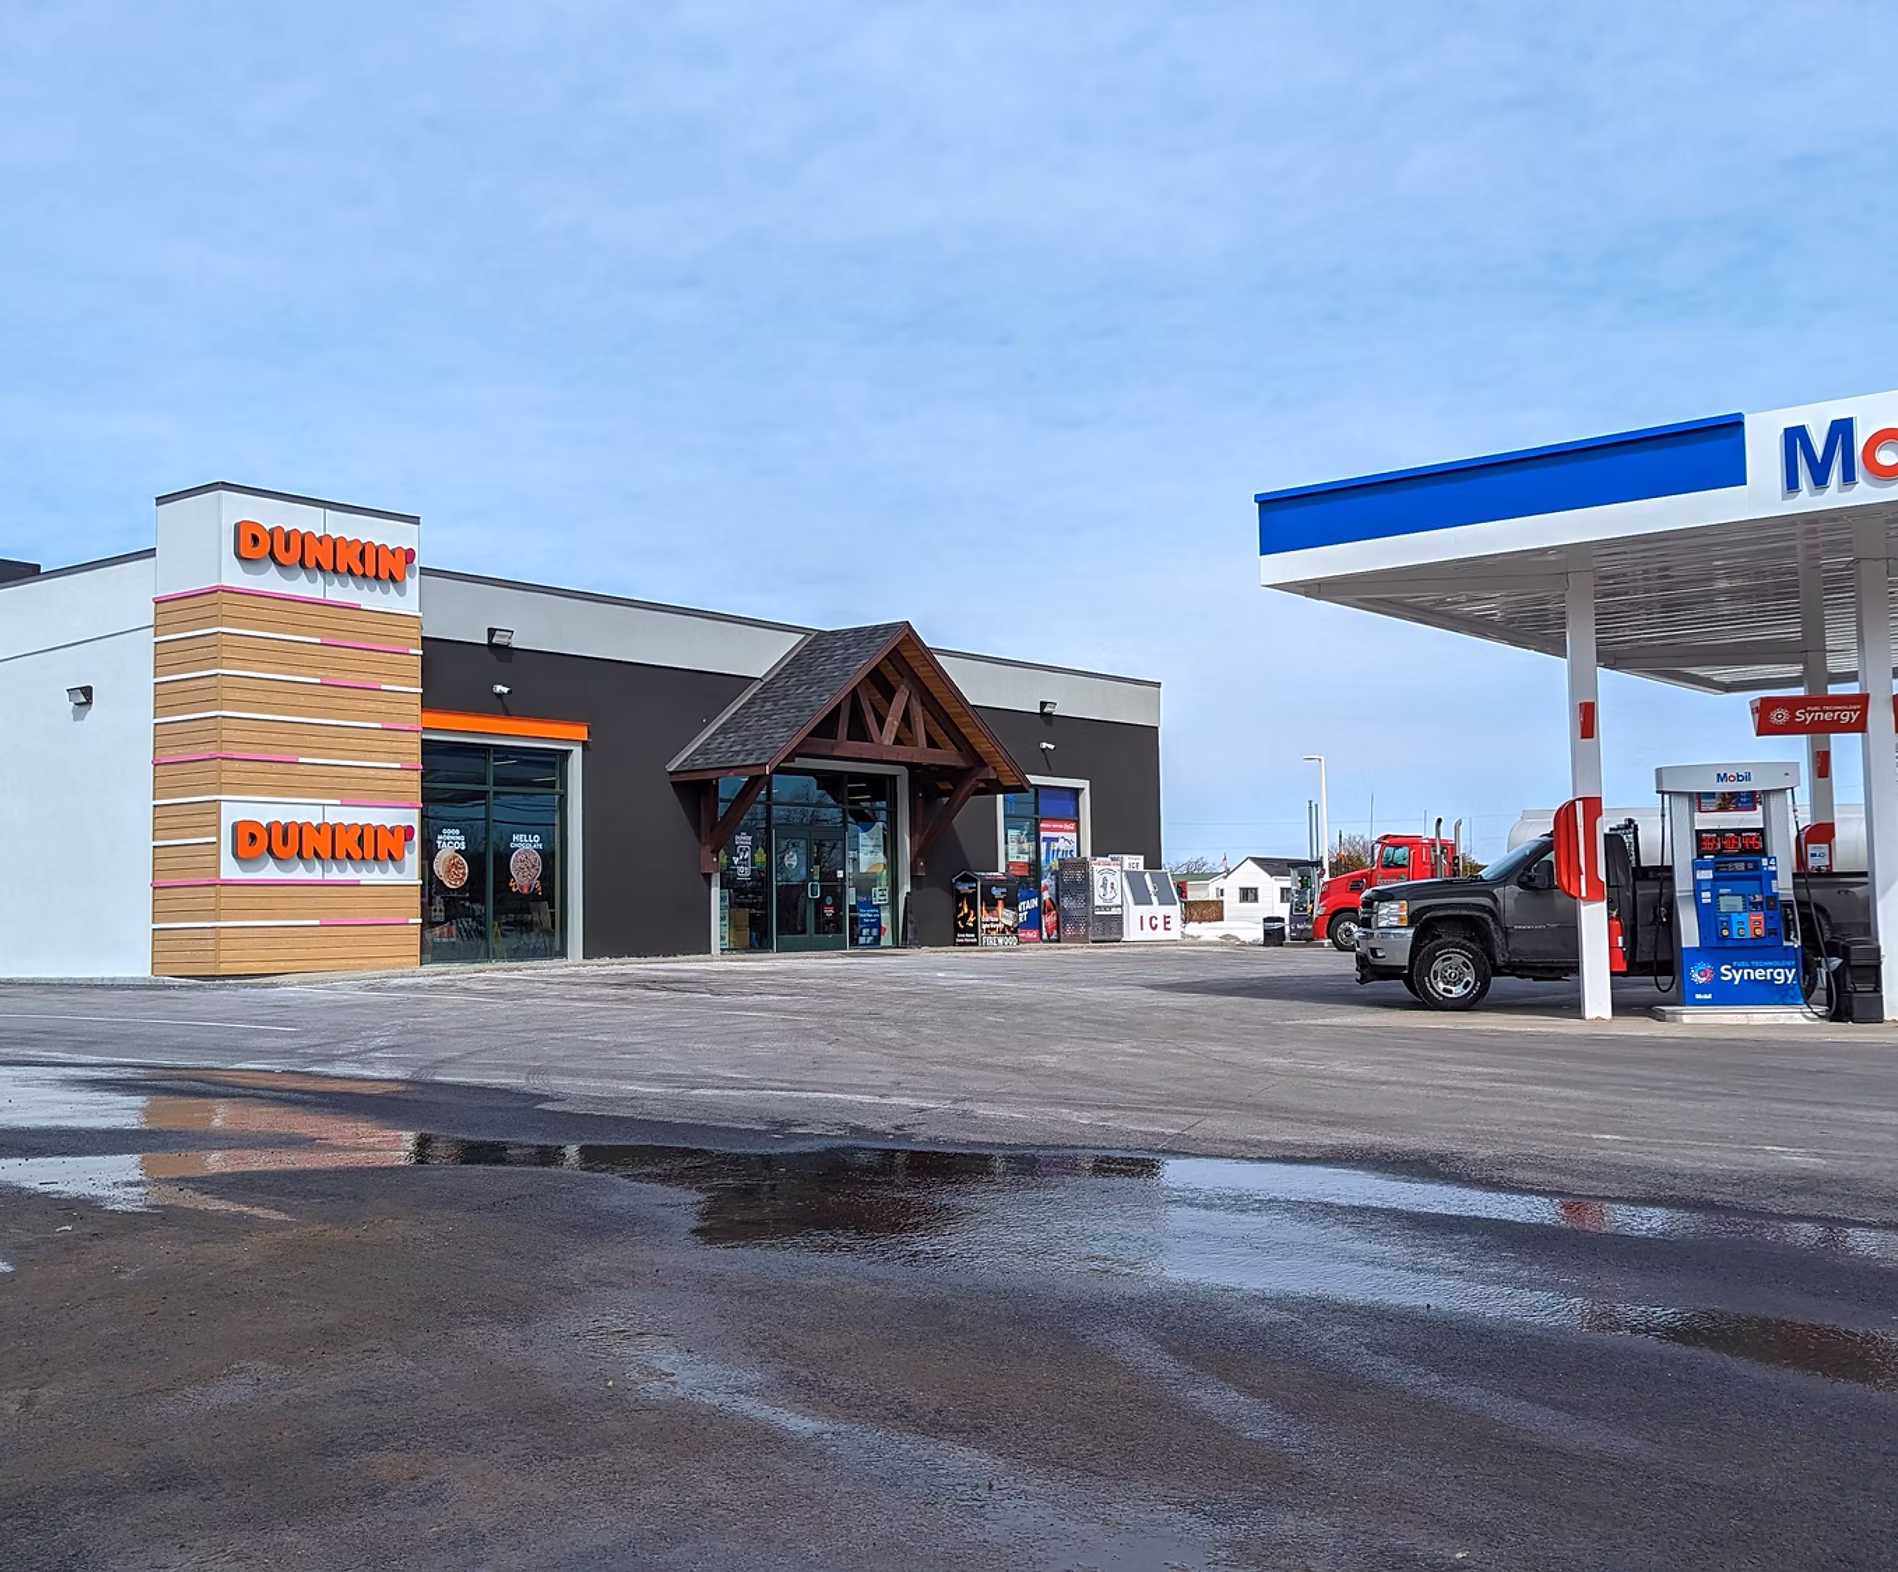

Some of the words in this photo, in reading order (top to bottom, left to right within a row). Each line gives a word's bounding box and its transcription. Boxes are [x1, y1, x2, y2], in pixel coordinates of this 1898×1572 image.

[234, 520, 415, 583] DUNKIN'
[1795, 709, 1860, 725] Synergy
[1716, 772, 1752, 783] Mobil
[231, 820, 414, 861] DUNKIN'
[436, 841, 467, 850] TACOS
[512, 834, 541, 843] HELLO
[1140, 914, 1172, 931] ICE
[983, 936, 1018, 946] FIREWOOD
[1720, 964, 1796, 985] Synergy
